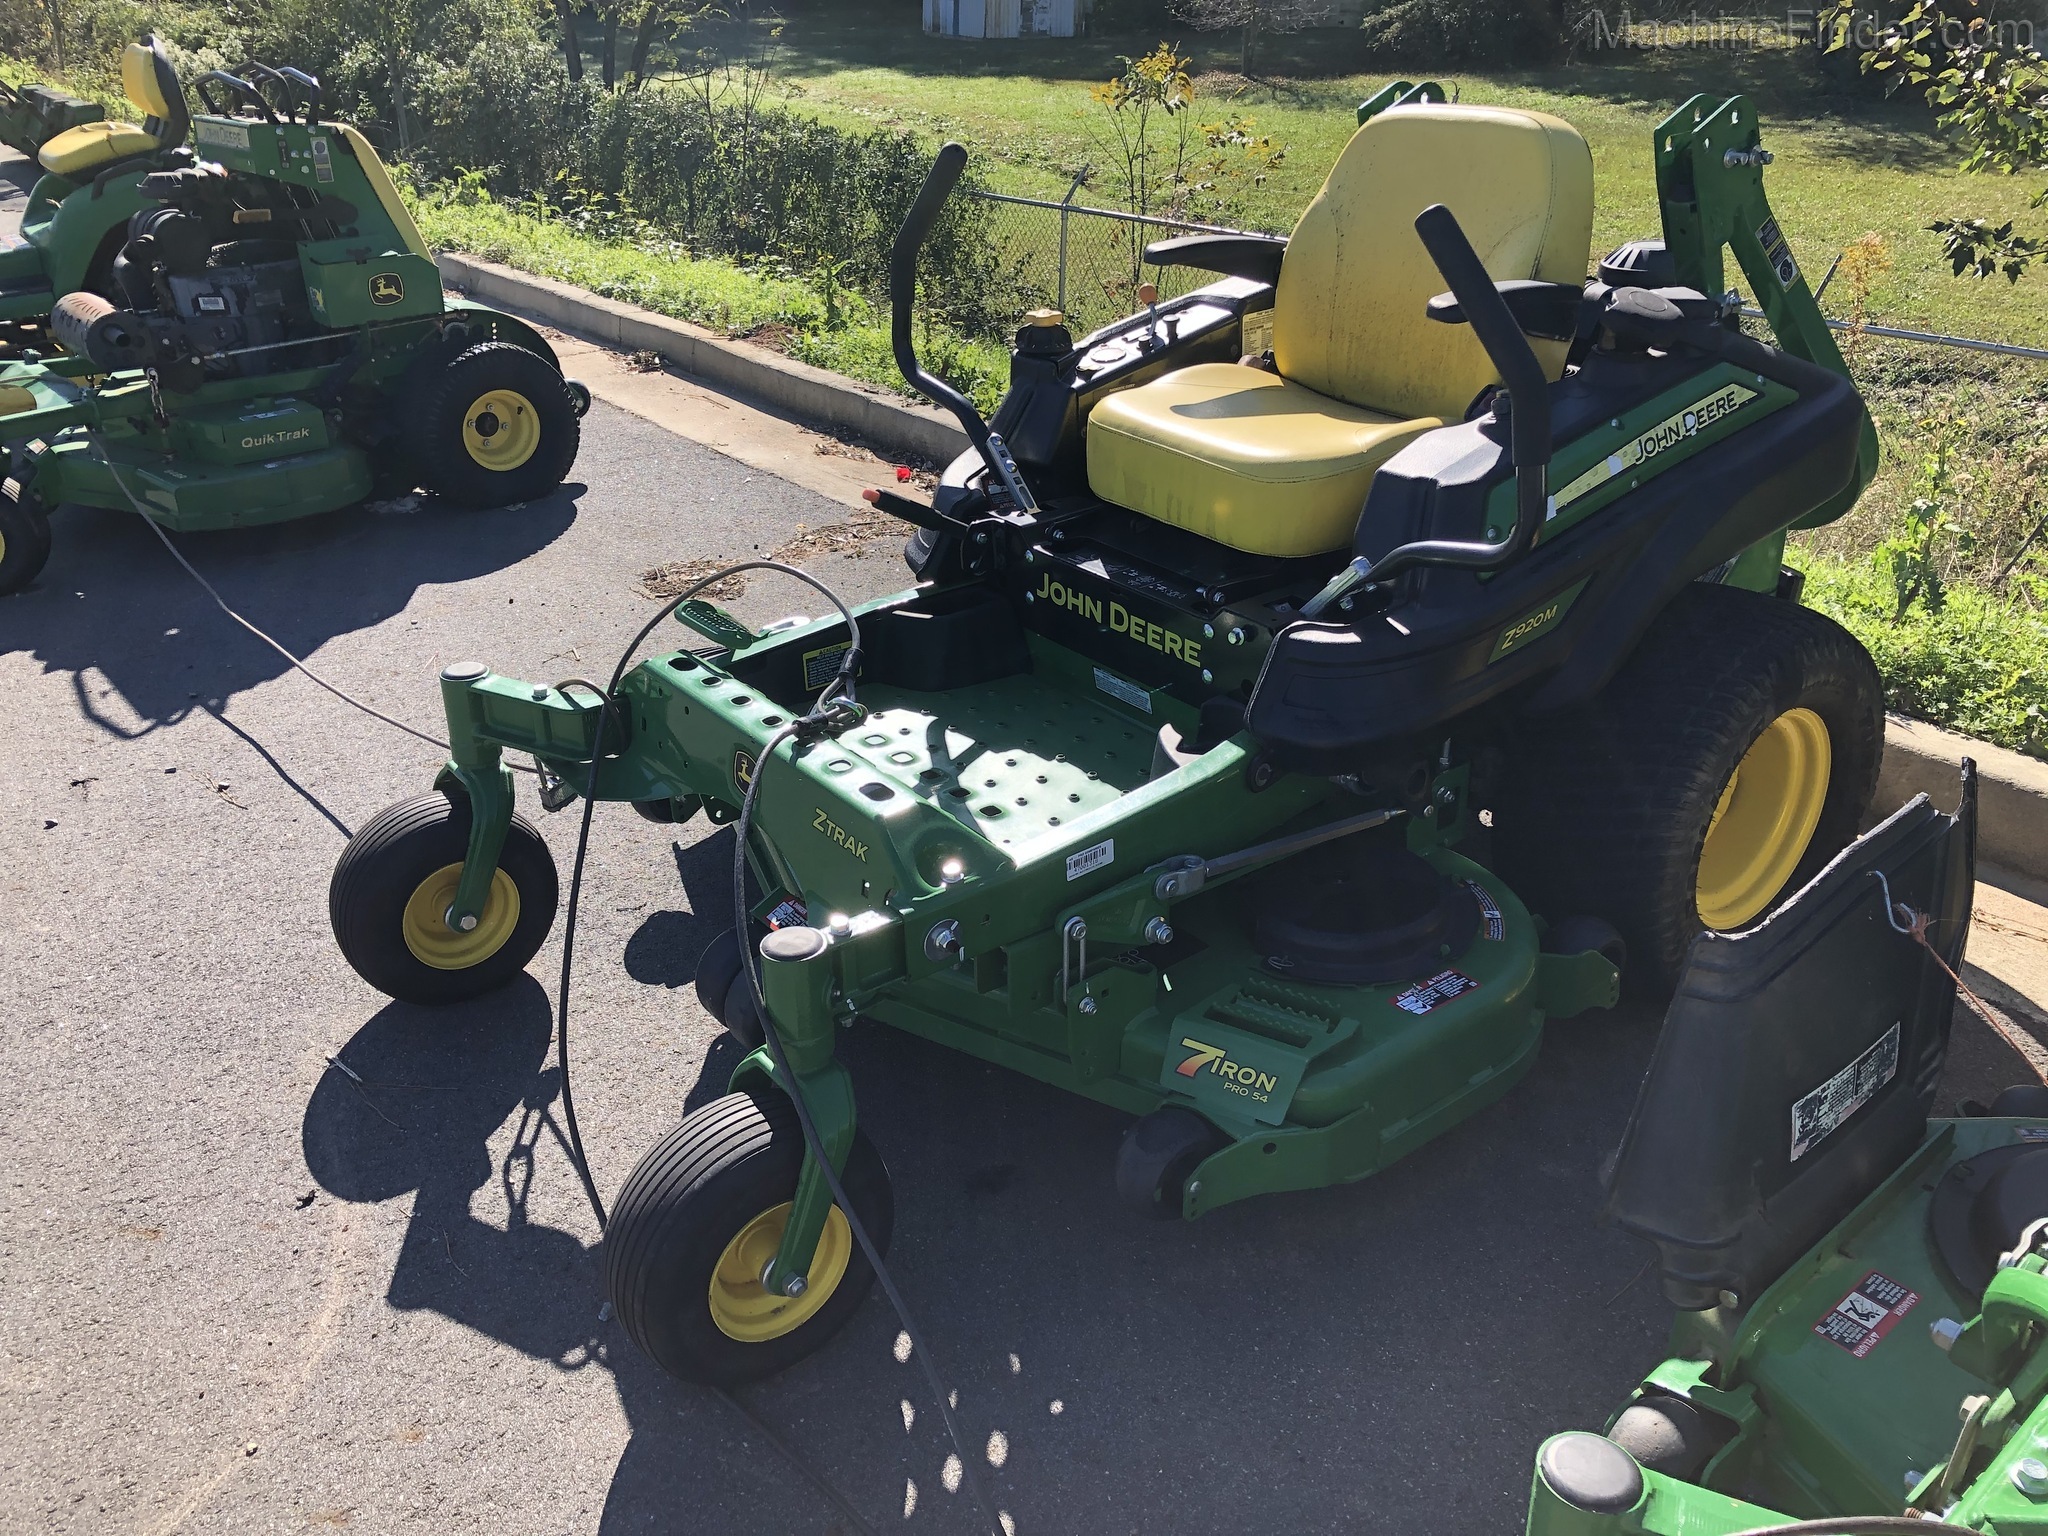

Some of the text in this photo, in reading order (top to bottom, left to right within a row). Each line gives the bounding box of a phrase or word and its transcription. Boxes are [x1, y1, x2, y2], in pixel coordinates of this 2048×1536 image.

[1634, 390, 1738, 462] JOHN DEERE
[1037, 572, 1102, 624] JOHN
[1109, 600, 1202, 668] DEERE
[1501, 604, 1558, 650] Z920M
[812, 807, 869, 862] ZTRAK
[1223, 1082, 1269, 1103] PRO 54
